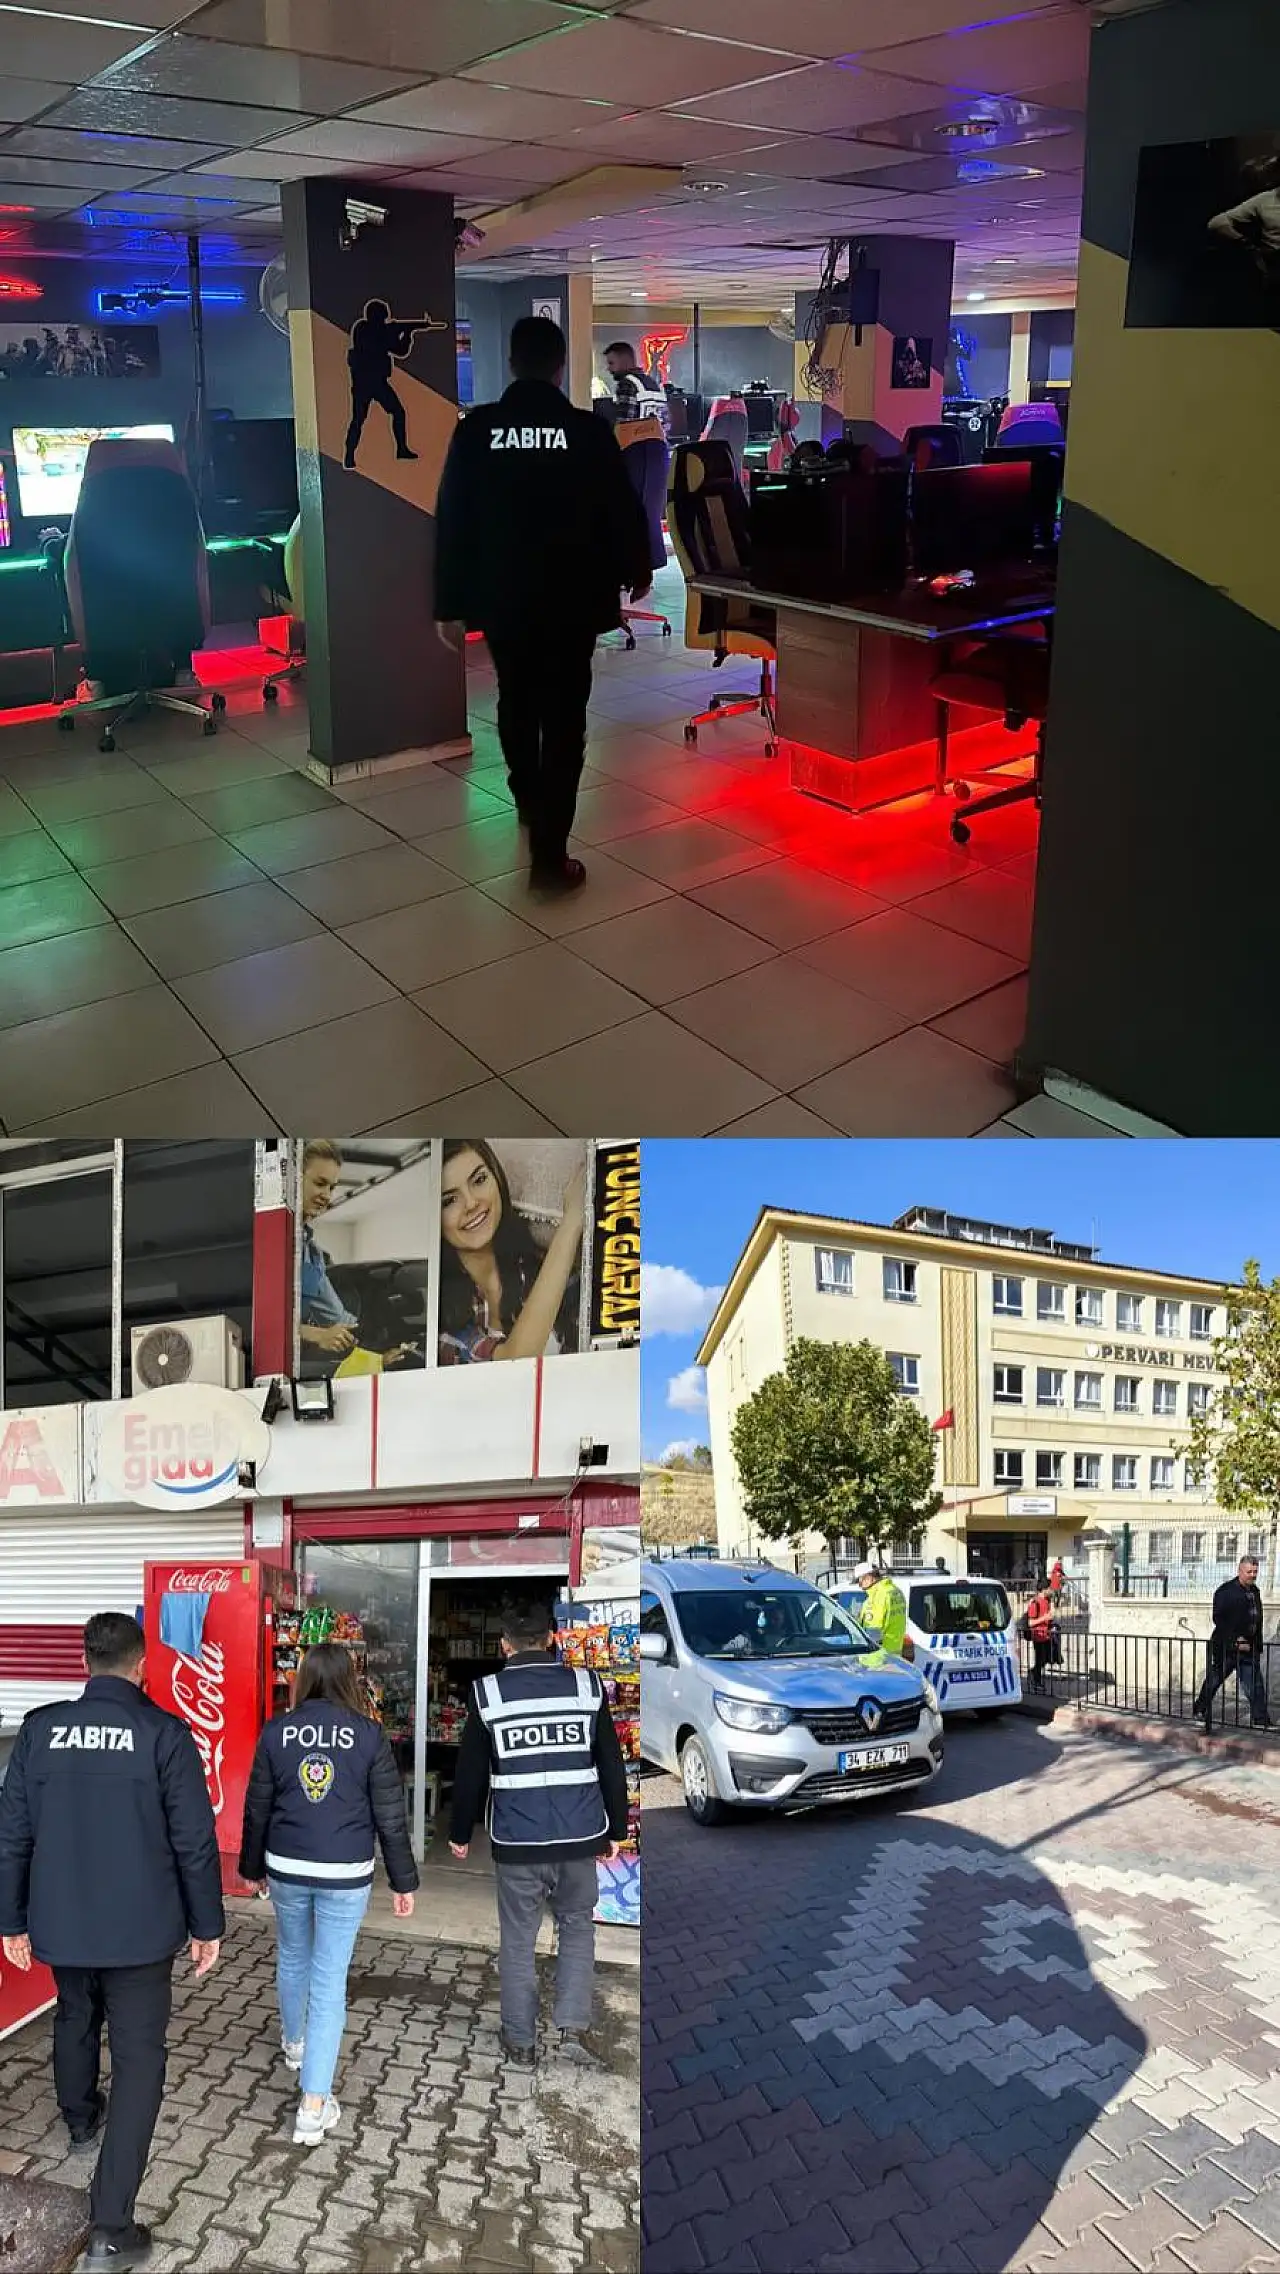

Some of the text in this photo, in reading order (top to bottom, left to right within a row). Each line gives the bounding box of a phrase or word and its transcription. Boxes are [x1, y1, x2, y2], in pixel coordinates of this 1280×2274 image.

[490, 427, 568, 449] ZABITA
[1183, 1353, 1217, 1371] MEV
[168, 1568, 233, 1592] Coca-Cola
[49, 1725, 135, 1752] ZABITA
[282, 1724, 355, 1749] POLİS
[507, 1724, 580, 1748] POLİS
[847, 1754, 860, 1767] 34
[866, 1750, 885, 1764] EZK
